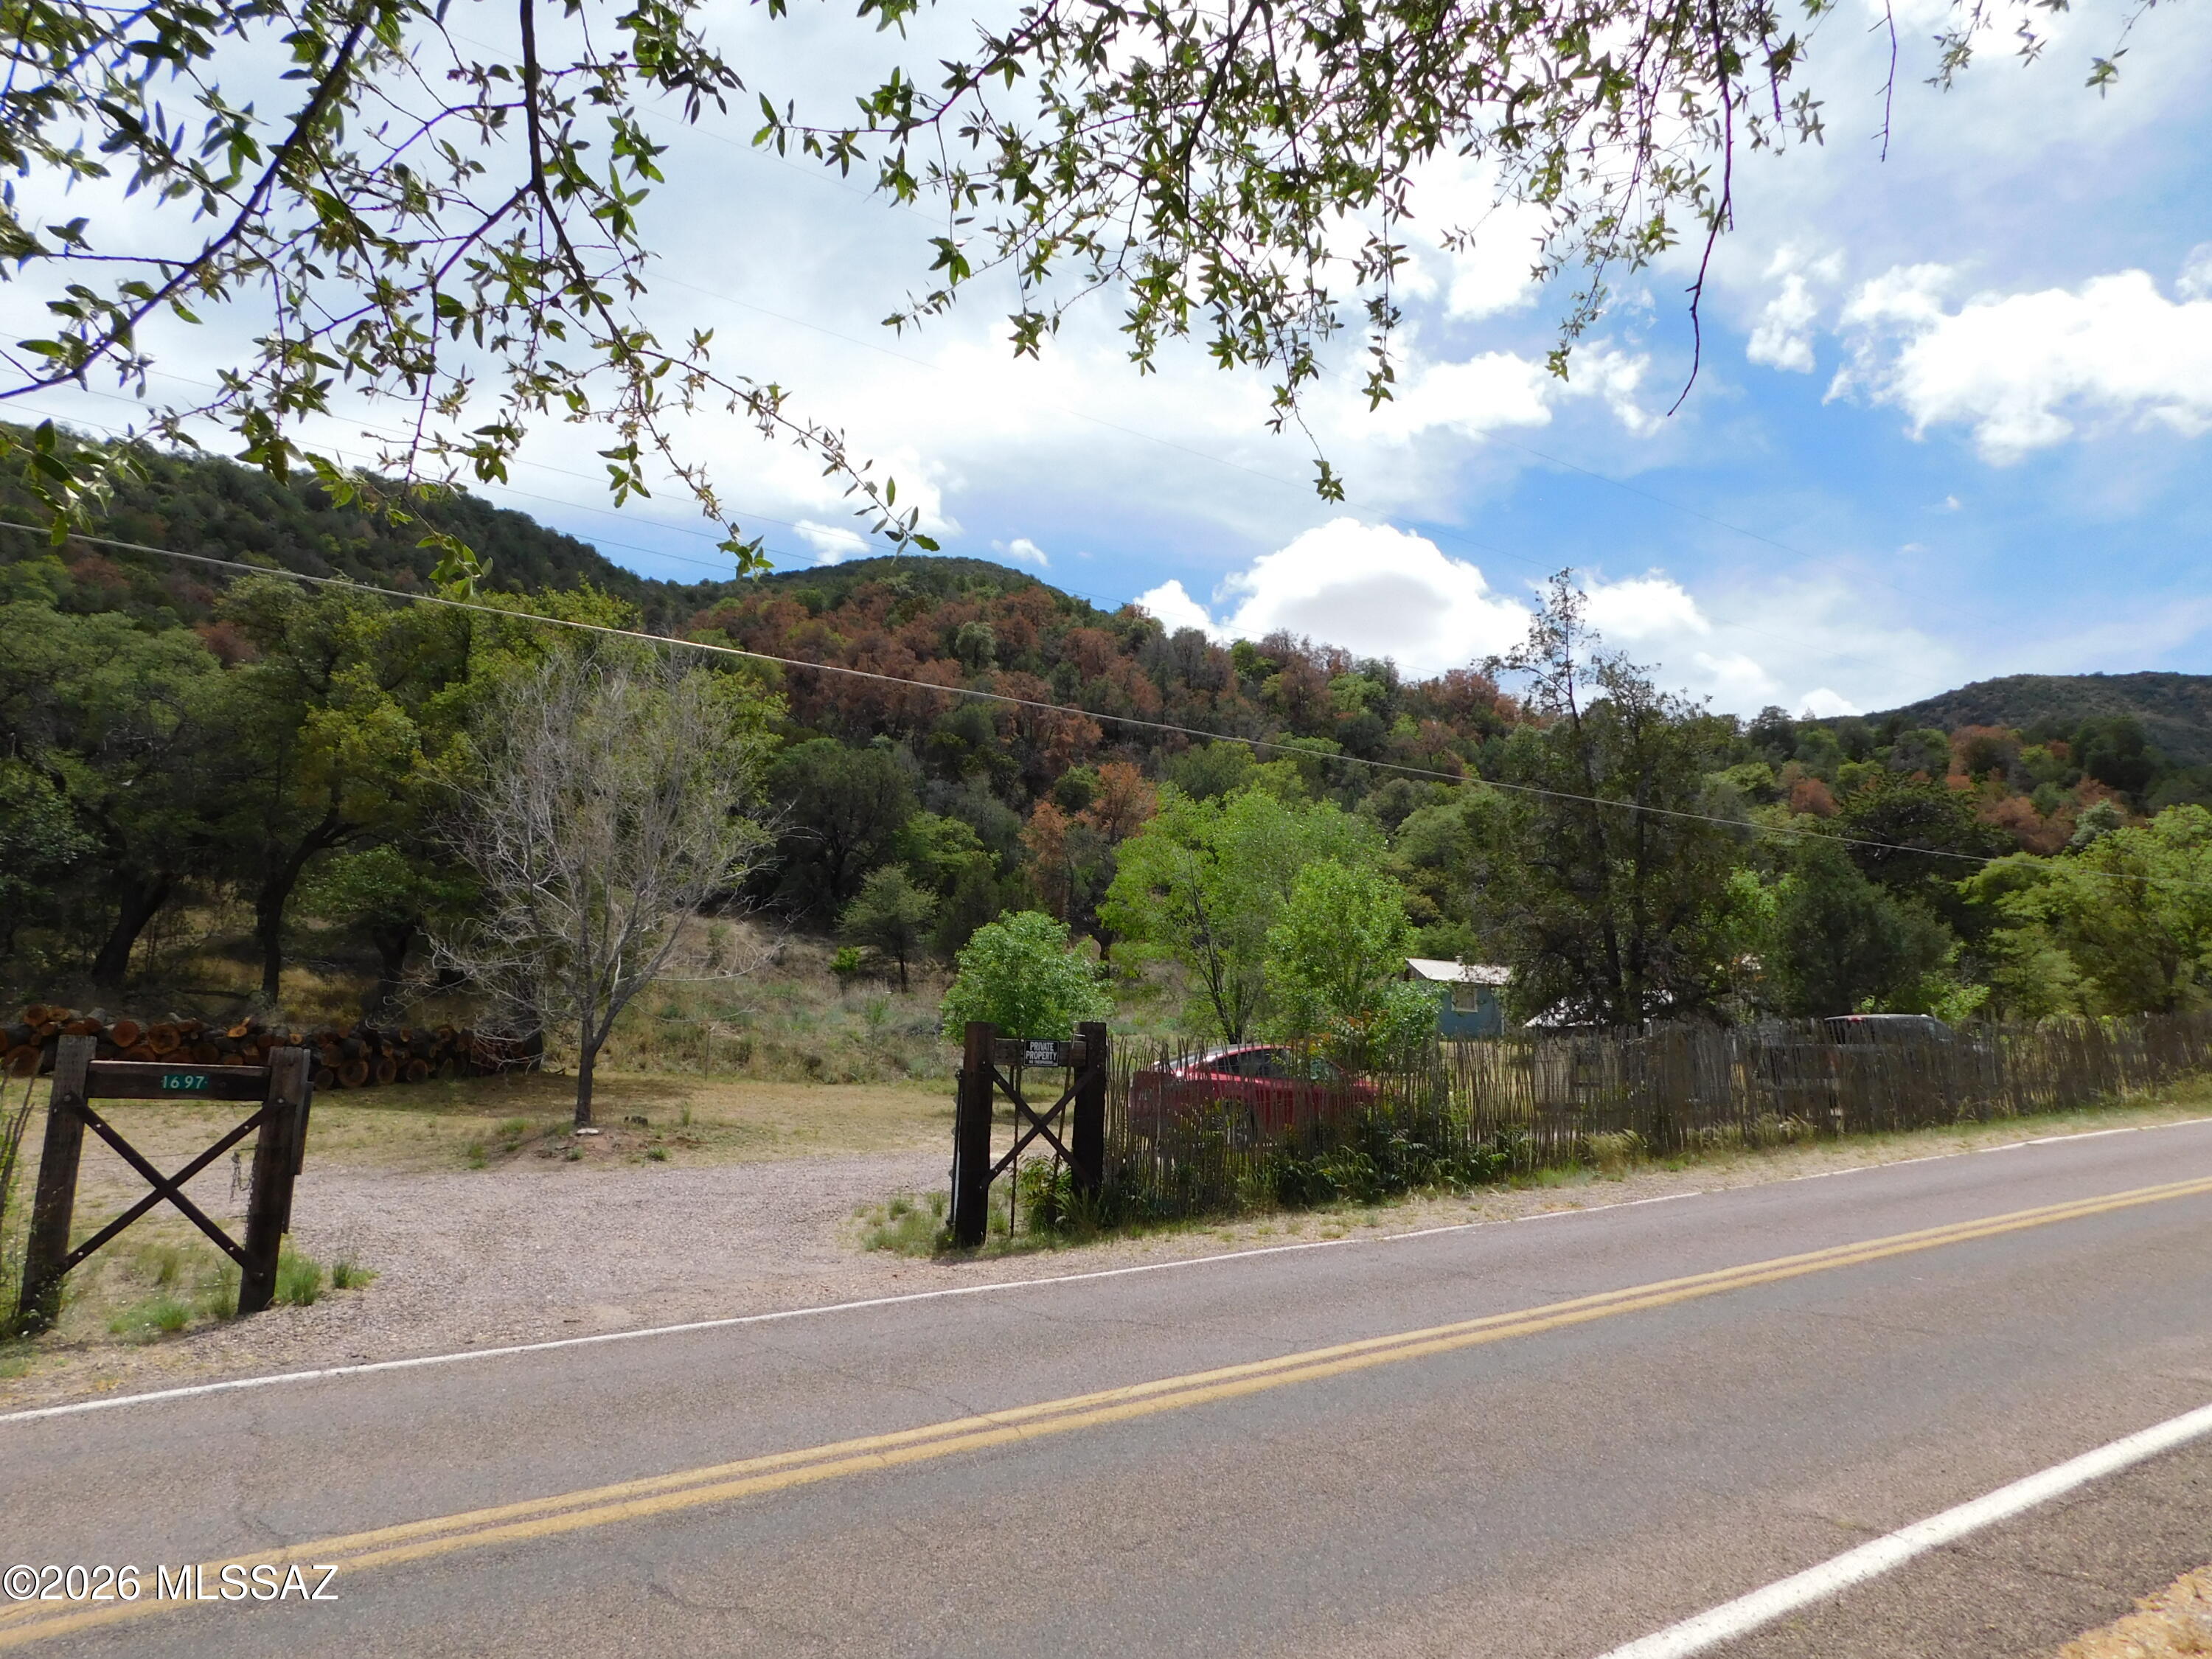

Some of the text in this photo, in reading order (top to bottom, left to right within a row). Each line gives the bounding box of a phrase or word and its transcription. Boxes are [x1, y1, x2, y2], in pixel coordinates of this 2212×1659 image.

[1030, 1042, 1054, 1051] PRIVATE
[1026, 1051, 1057, 1060] PROPERTY
[163, 1075, 204, 1088] 1697
